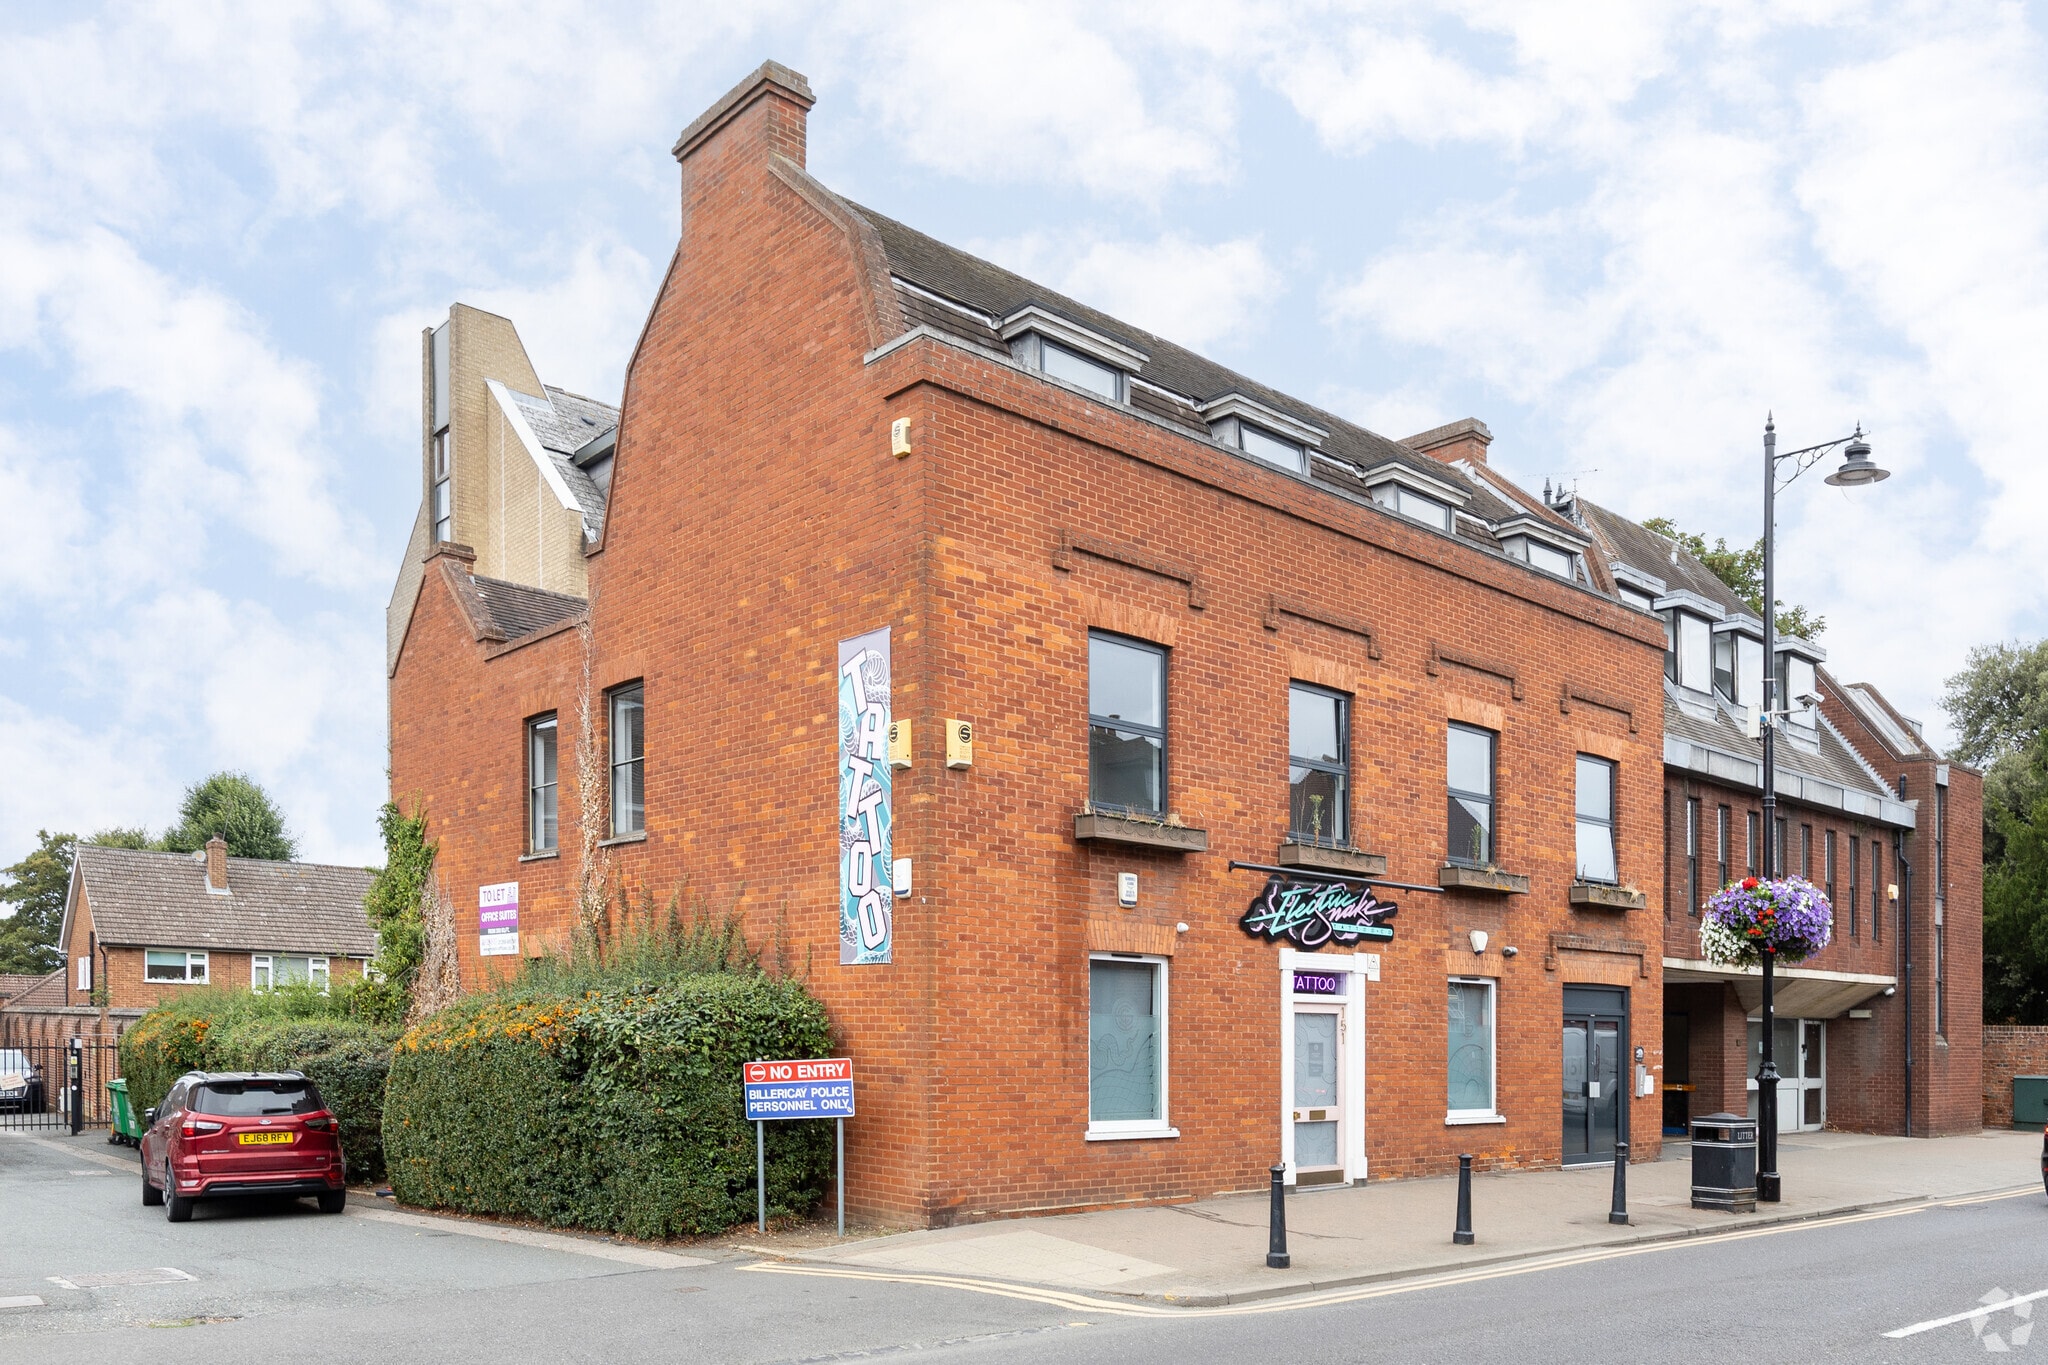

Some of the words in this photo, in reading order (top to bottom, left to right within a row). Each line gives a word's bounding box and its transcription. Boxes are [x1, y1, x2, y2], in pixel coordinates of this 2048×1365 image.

[842, 647, 887, 950] TATTOO
[482, 890, 492, 903] TO
[493, 888, 505, 902] LET
[481, 911, 499, 923] OFFICE
[499, 909, 517, 921] SUITES
[1245, 884, 1359, 936] Electric
[1302, 883, 1396, 946] Snake
[769, 1065, 793, 1079] NO
[797, 1063, 846, 1079] ENTRY
[748, 1087, 808, 1100] BILLERICAY
[811, 1086, 850, 1098] POLICE
[749, 1100, 818, 1113] PERSONNEL
[821, 1099, 850, 1110] ONLY
[243, 1133, 269, 1143] EJ68
[270, 1133, 289, 1142] RFY
[1737, 1131, 1754, 1140] LITTER
